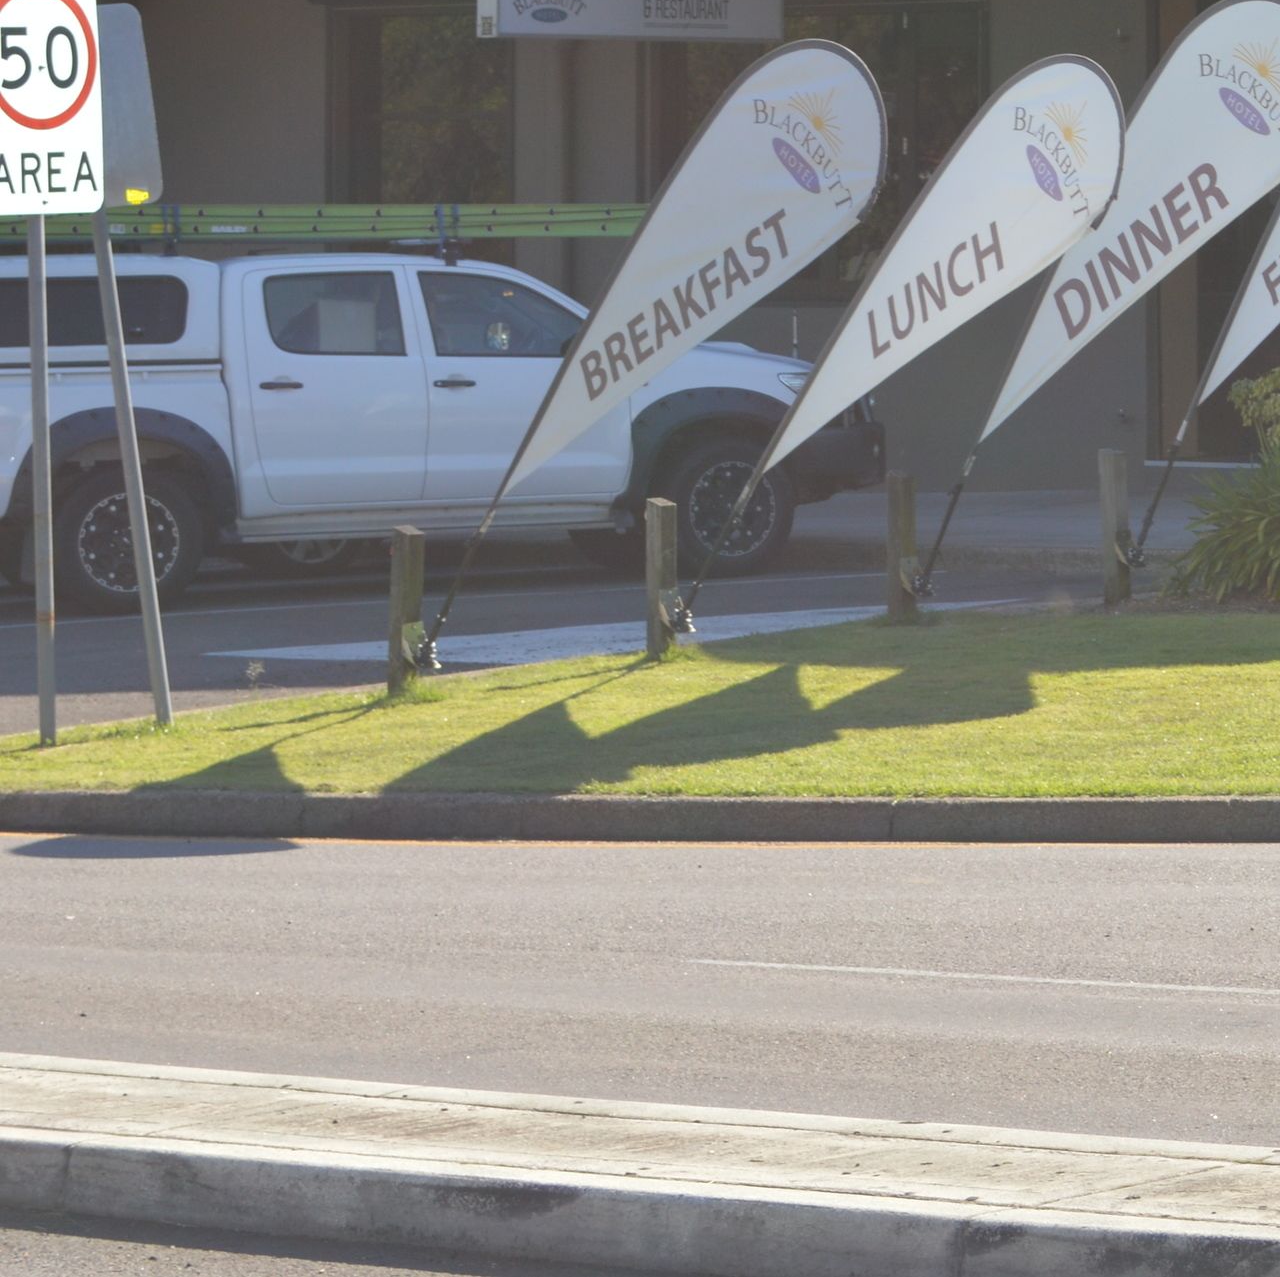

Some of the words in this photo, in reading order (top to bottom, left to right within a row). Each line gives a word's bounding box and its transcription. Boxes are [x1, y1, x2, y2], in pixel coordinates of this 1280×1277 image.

[0, 25, 78, 90] 50
[753, 98, 853, 209] BLACKBUTT
[1226, 94, 1262, 131] HOTEL
[0, 150, 97, 194] AREA
[780, 145, 816, 190] HOTEL
[1013, 106, 1091, 218] BLACKBUTT
[1031, 152, 1056, 196] HOTEL
[867, 221, 1005, 360] LUNCH
[1053, 162, 1230, 341] DINNER
[580, 209, 791, 402] BREAKFAST
